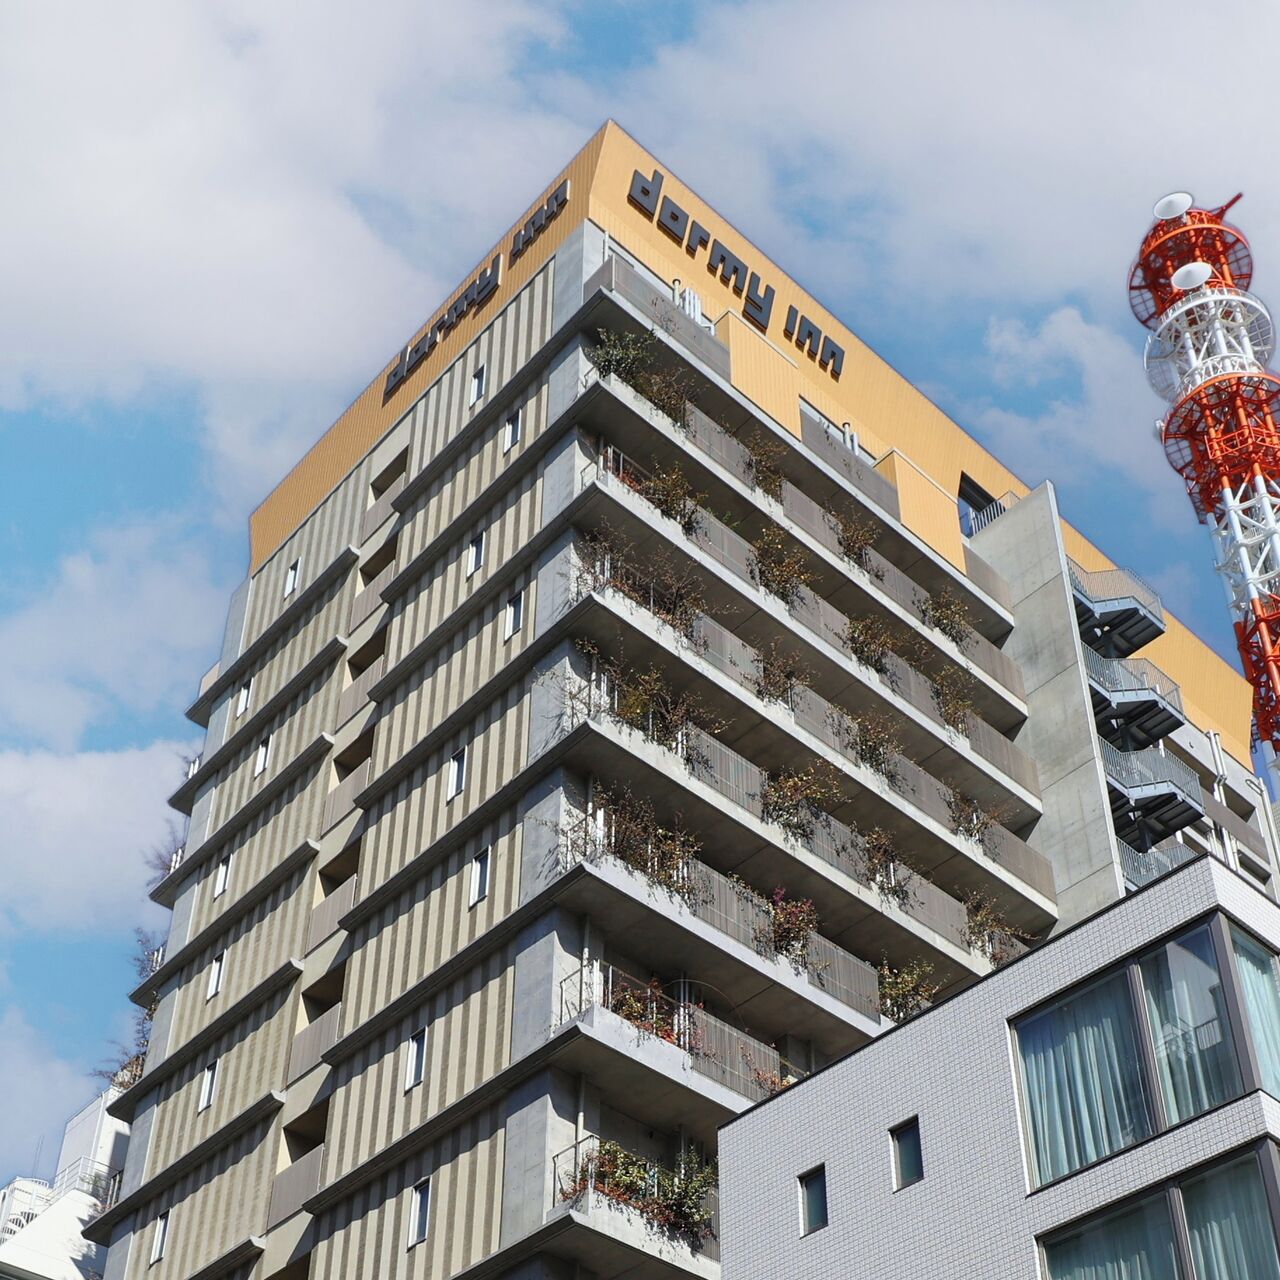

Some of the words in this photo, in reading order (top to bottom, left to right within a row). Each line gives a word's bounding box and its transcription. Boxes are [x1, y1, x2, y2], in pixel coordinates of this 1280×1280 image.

[383, 252, 503, 398] dormy
[512, 178, 570, 257] inn
[627, 169, 776, 336] dormy
[784, 304, 845, 383] inn
